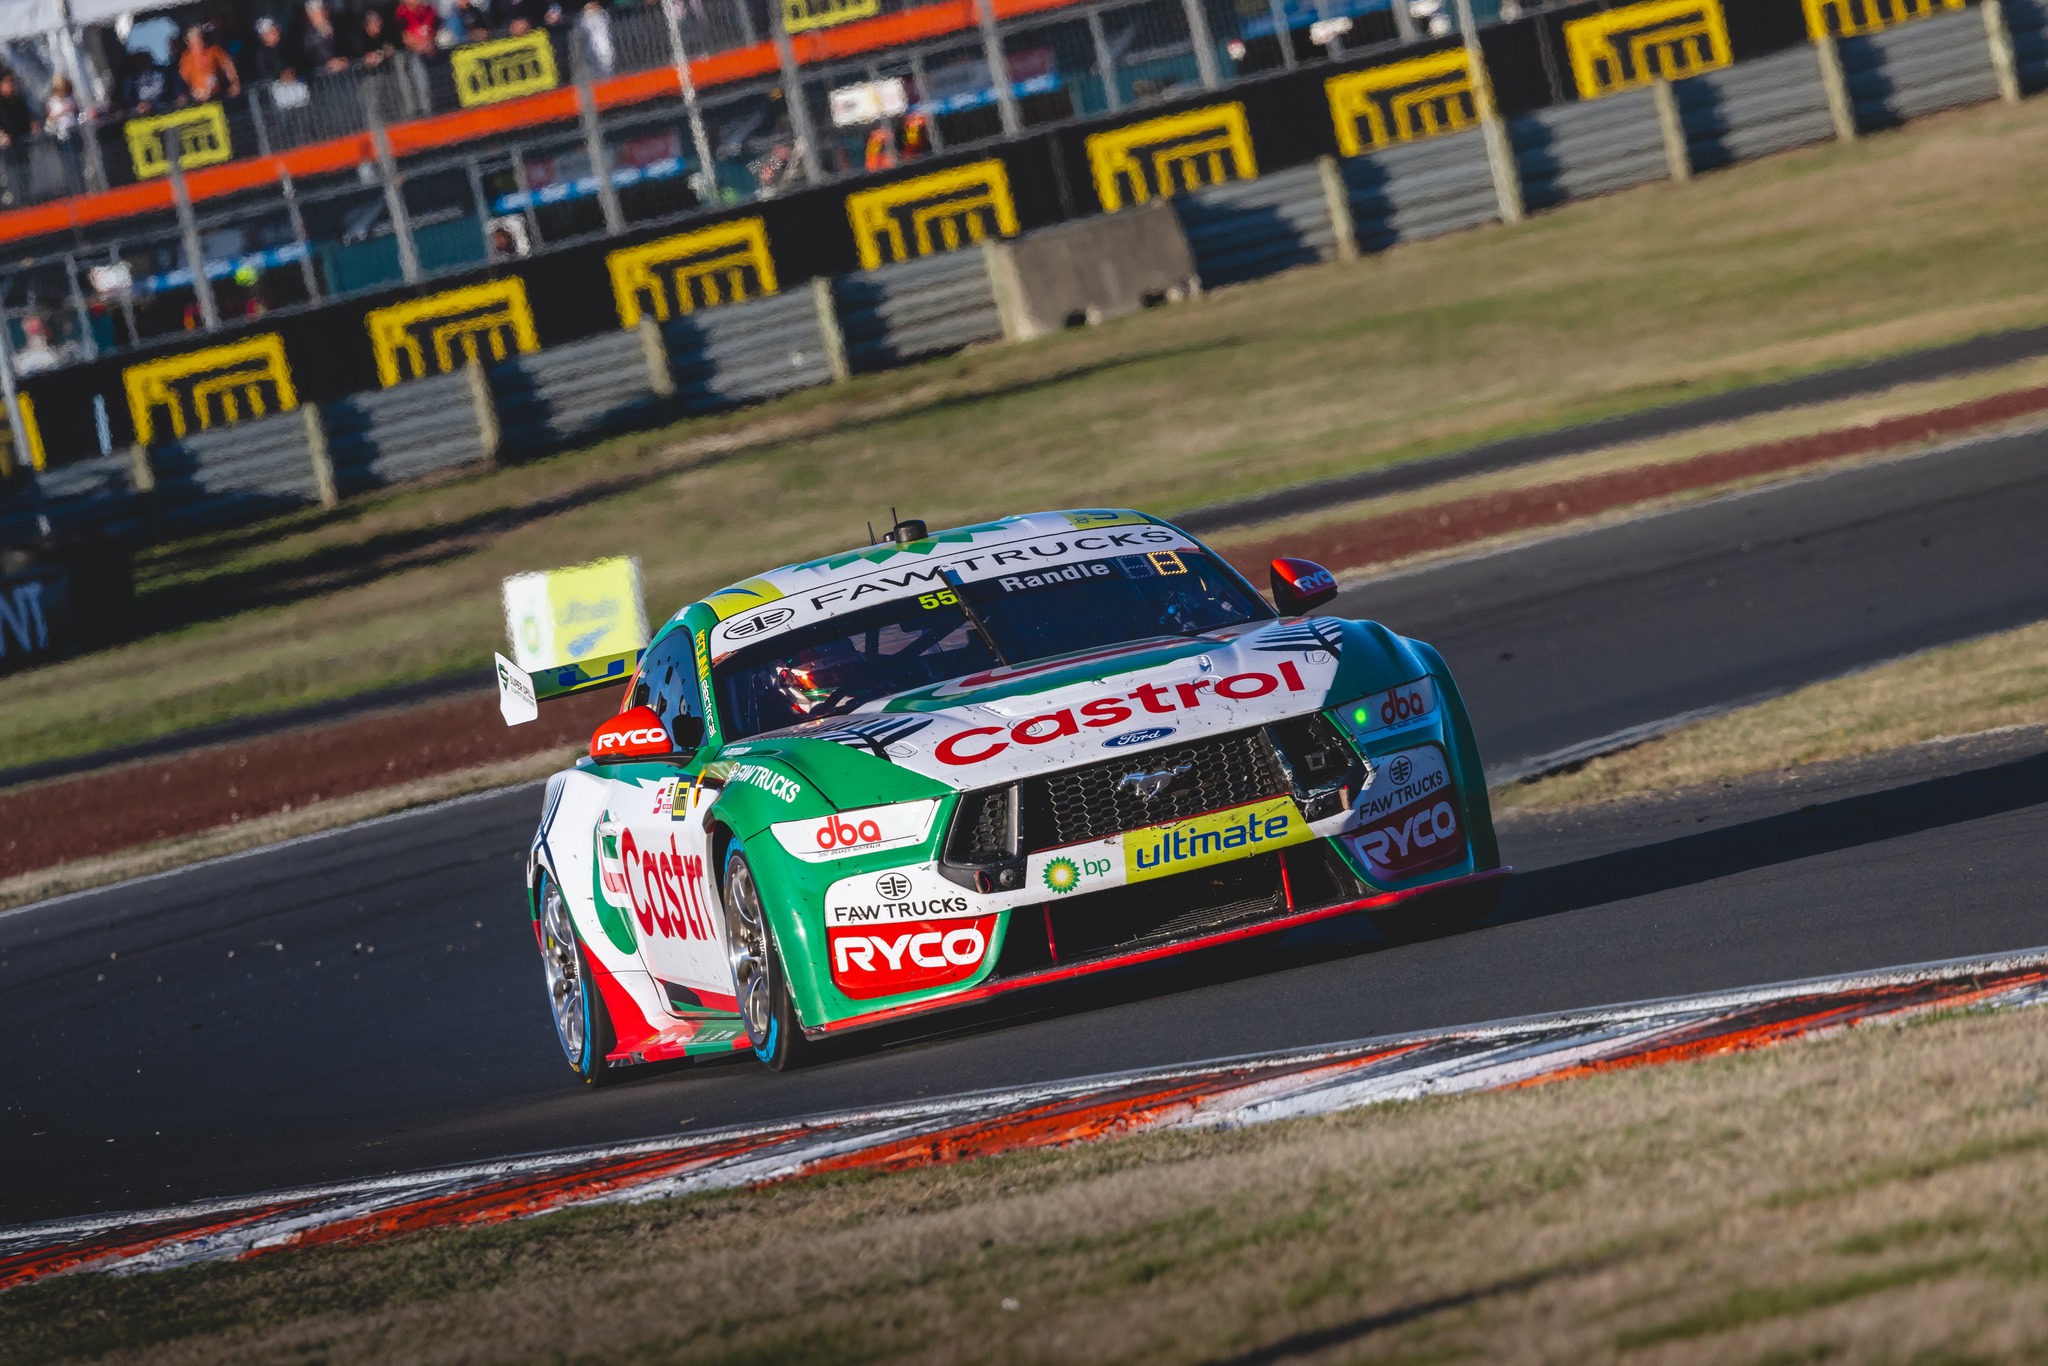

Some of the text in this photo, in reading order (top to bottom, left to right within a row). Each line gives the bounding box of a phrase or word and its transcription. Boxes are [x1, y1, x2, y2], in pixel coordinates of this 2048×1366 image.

[809, 530, 1174, 611] FAW TRUCKS
[1000, 561, 1110, 593] Randle
[919, 590, 958, 610] 55
[700, 679, 717, 739] electrical
[1381, 687, 1424, 725] dba
[596, 727, 668, 752] RYCO
[1117, 729, 1161, 747] Ford
[750, 765, 801, 803] TRUCKS
[1359, 769, 1444, 820] FAW TRUCKS
[816, 815, 882, 849] dba
[1083, 812, 1289, 877] bp ultimate
[1353, 800, 1457, 870] RYCO
[834, 897, 969, 922] FAW TRUCKS
[834, 928, 985, 973] RYCO
